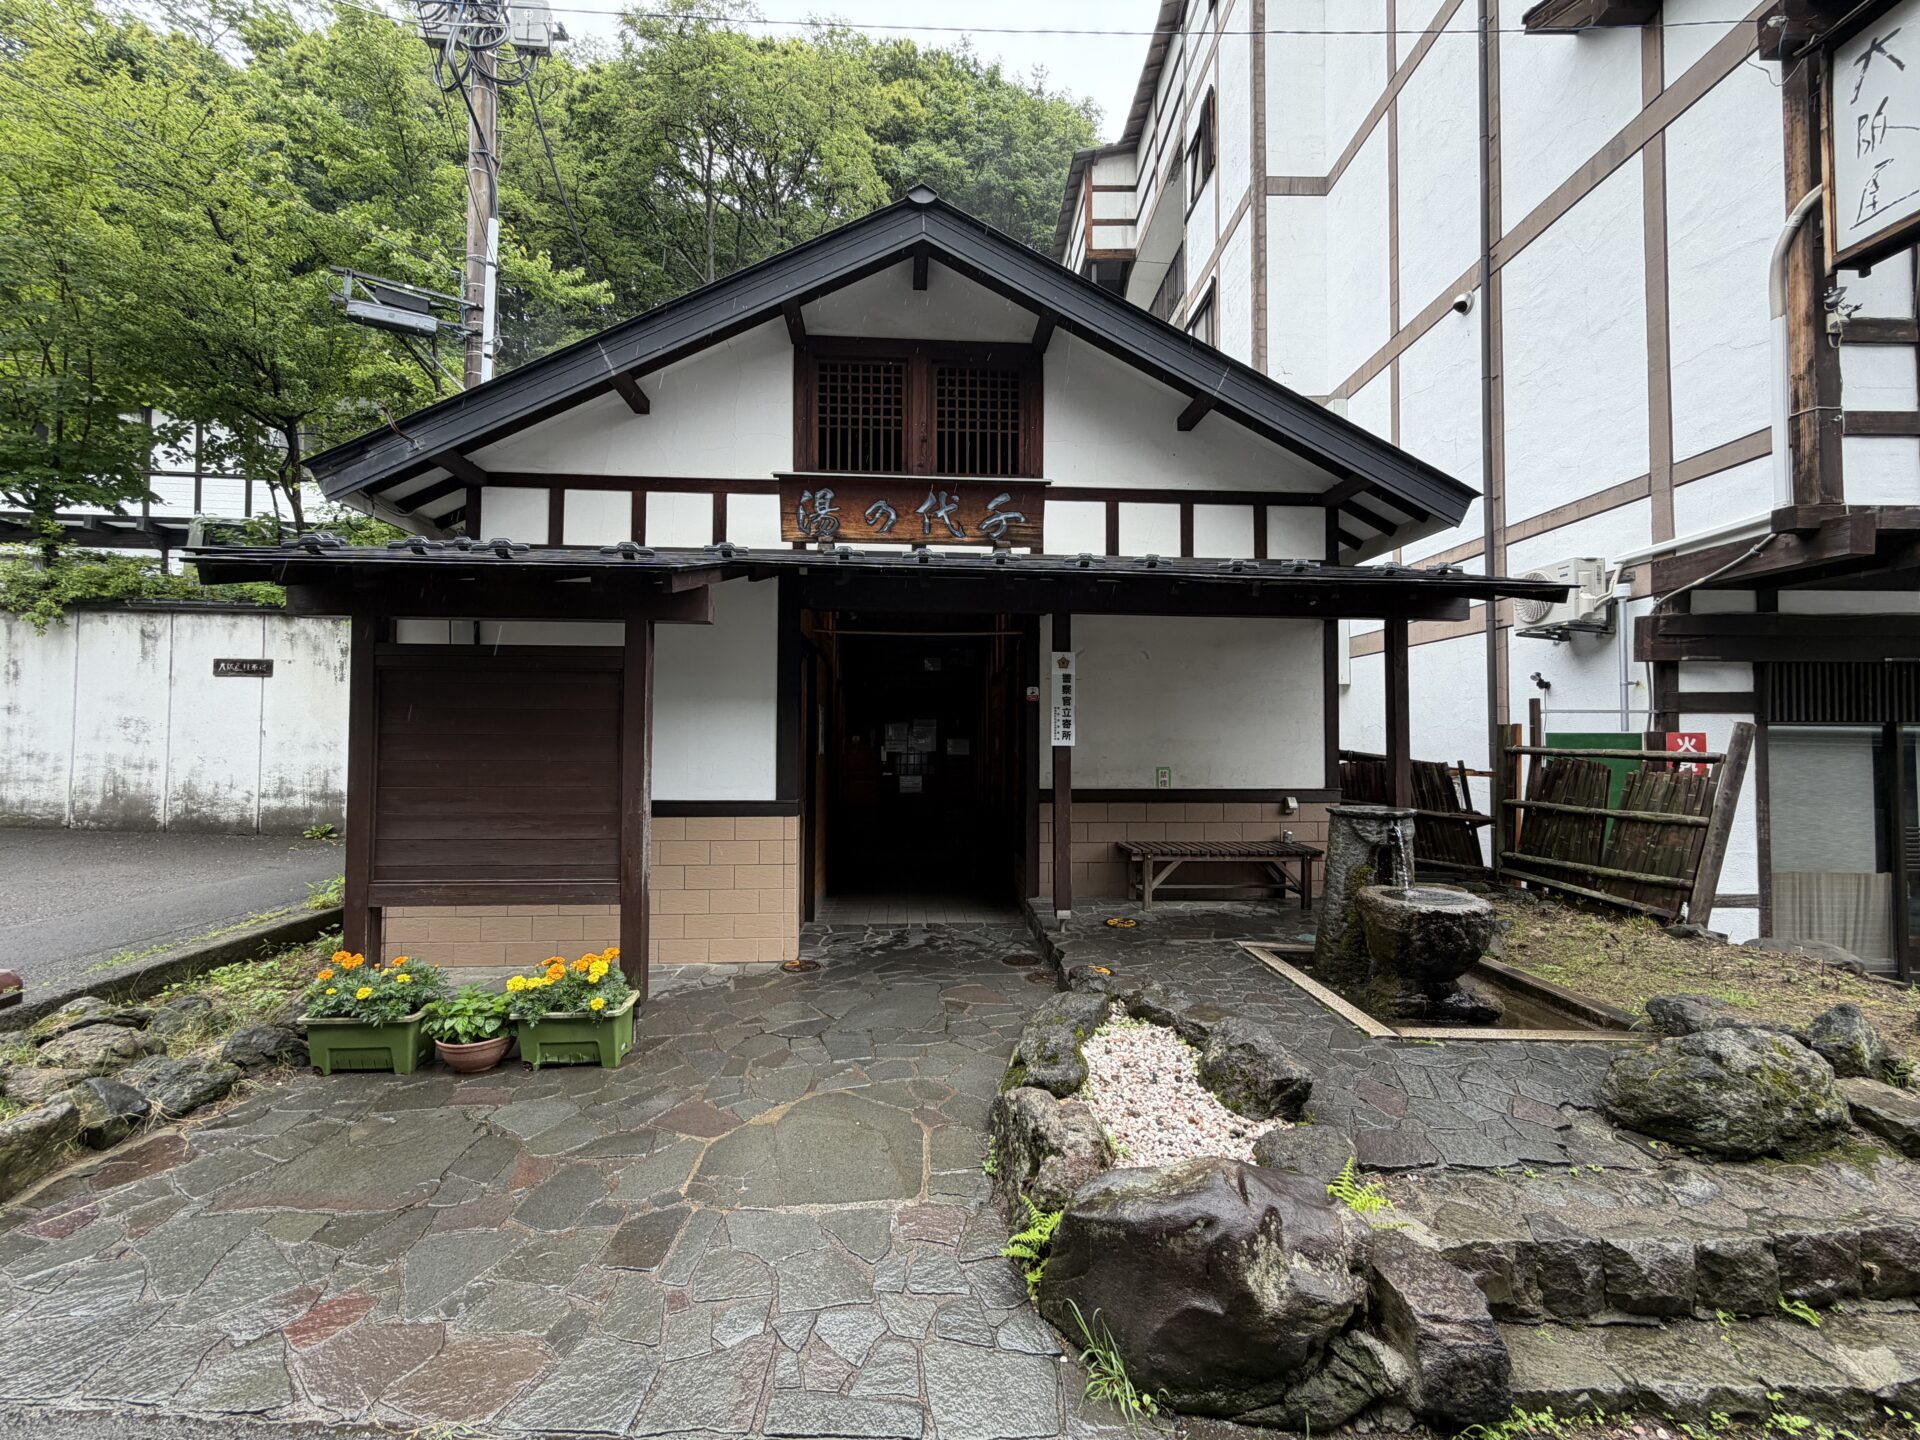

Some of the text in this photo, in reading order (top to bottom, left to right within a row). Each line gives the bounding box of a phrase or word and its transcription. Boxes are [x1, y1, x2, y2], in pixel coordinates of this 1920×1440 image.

[1849, 27, 1919, 230] 大阪屋
[1061, 673, 1072, 741] 警察官立寄所
